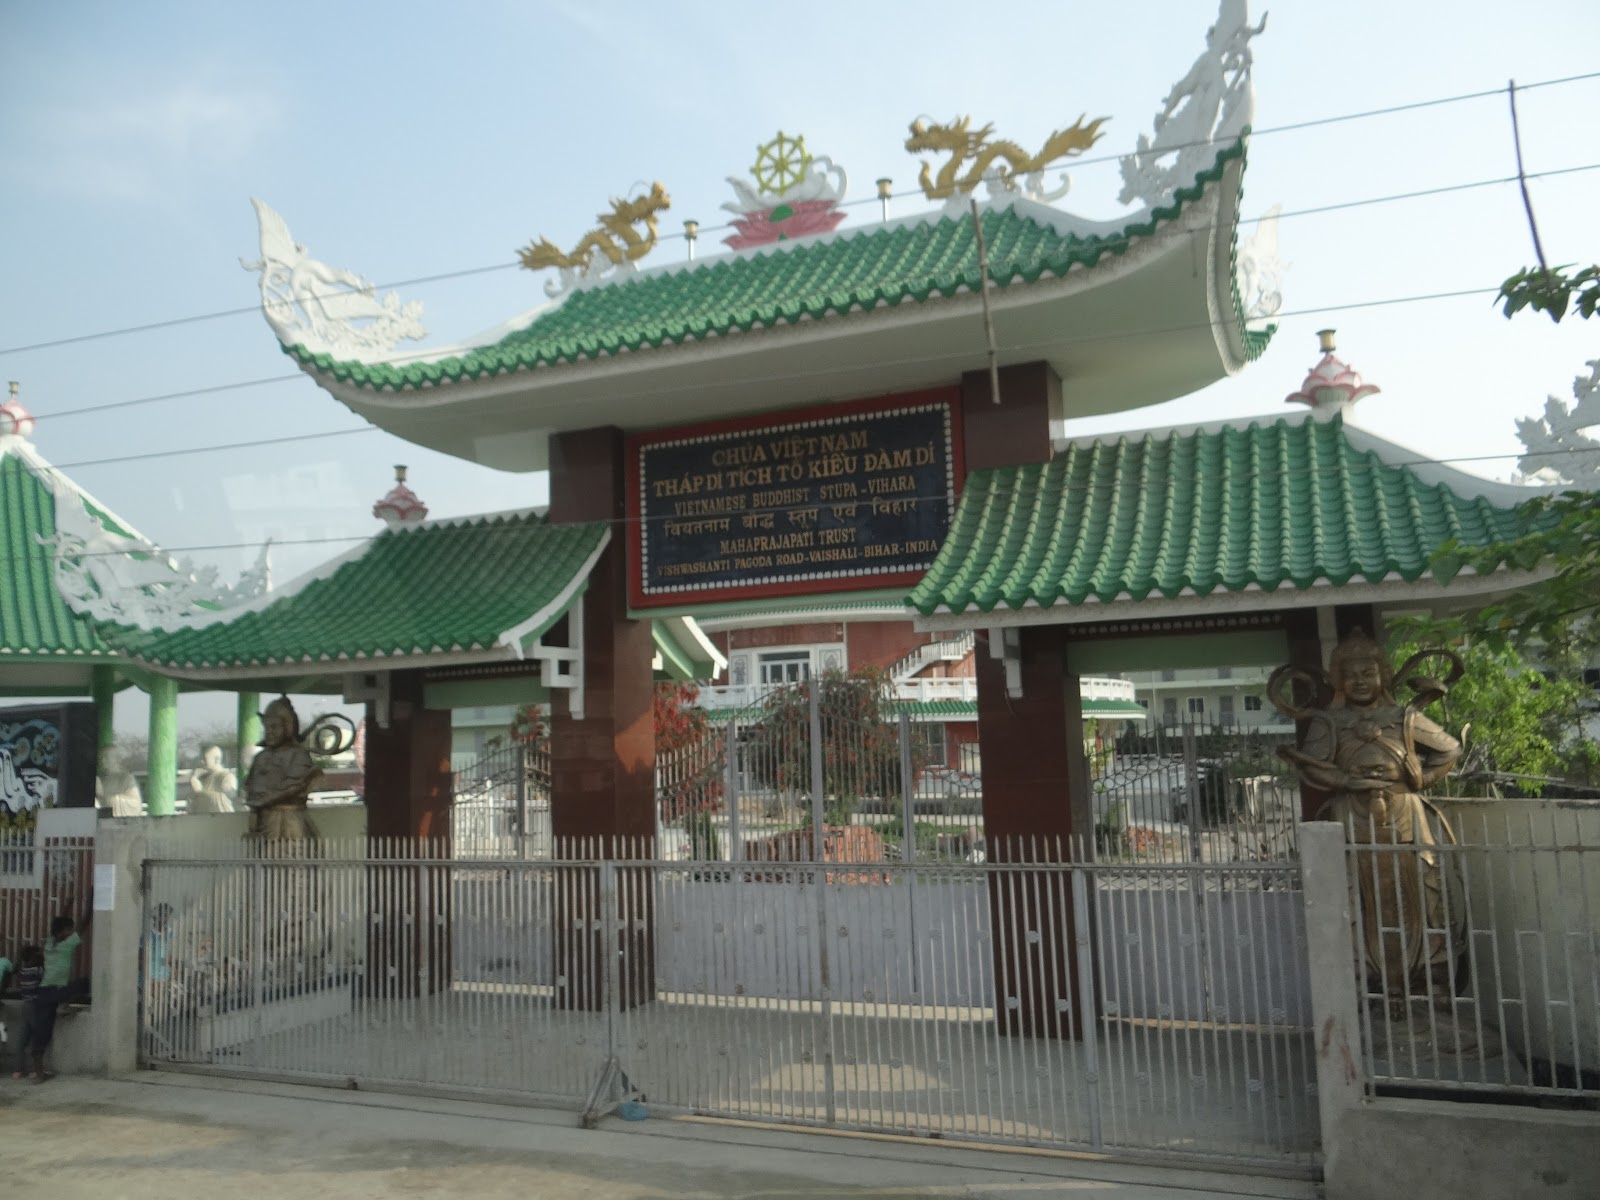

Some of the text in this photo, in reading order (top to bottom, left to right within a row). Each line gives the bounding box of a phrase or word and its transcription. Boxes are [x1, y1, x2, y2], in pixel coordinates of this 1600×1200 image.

[820, 430, 868, 452] NAM
[653, 472, 704, 497] THÁP
[674, 494, 746, 516] VIETNAMESE
[752, 487, 809, 508] BUDDHIST
[871, 496, 918, 516] विहार
[720, 528, 857, 555] MAHAPRAJAPATI TRUST
[656, 560, 731, 577] VISHWASHANTI
[735, 555, 772, 570] PAGODA
